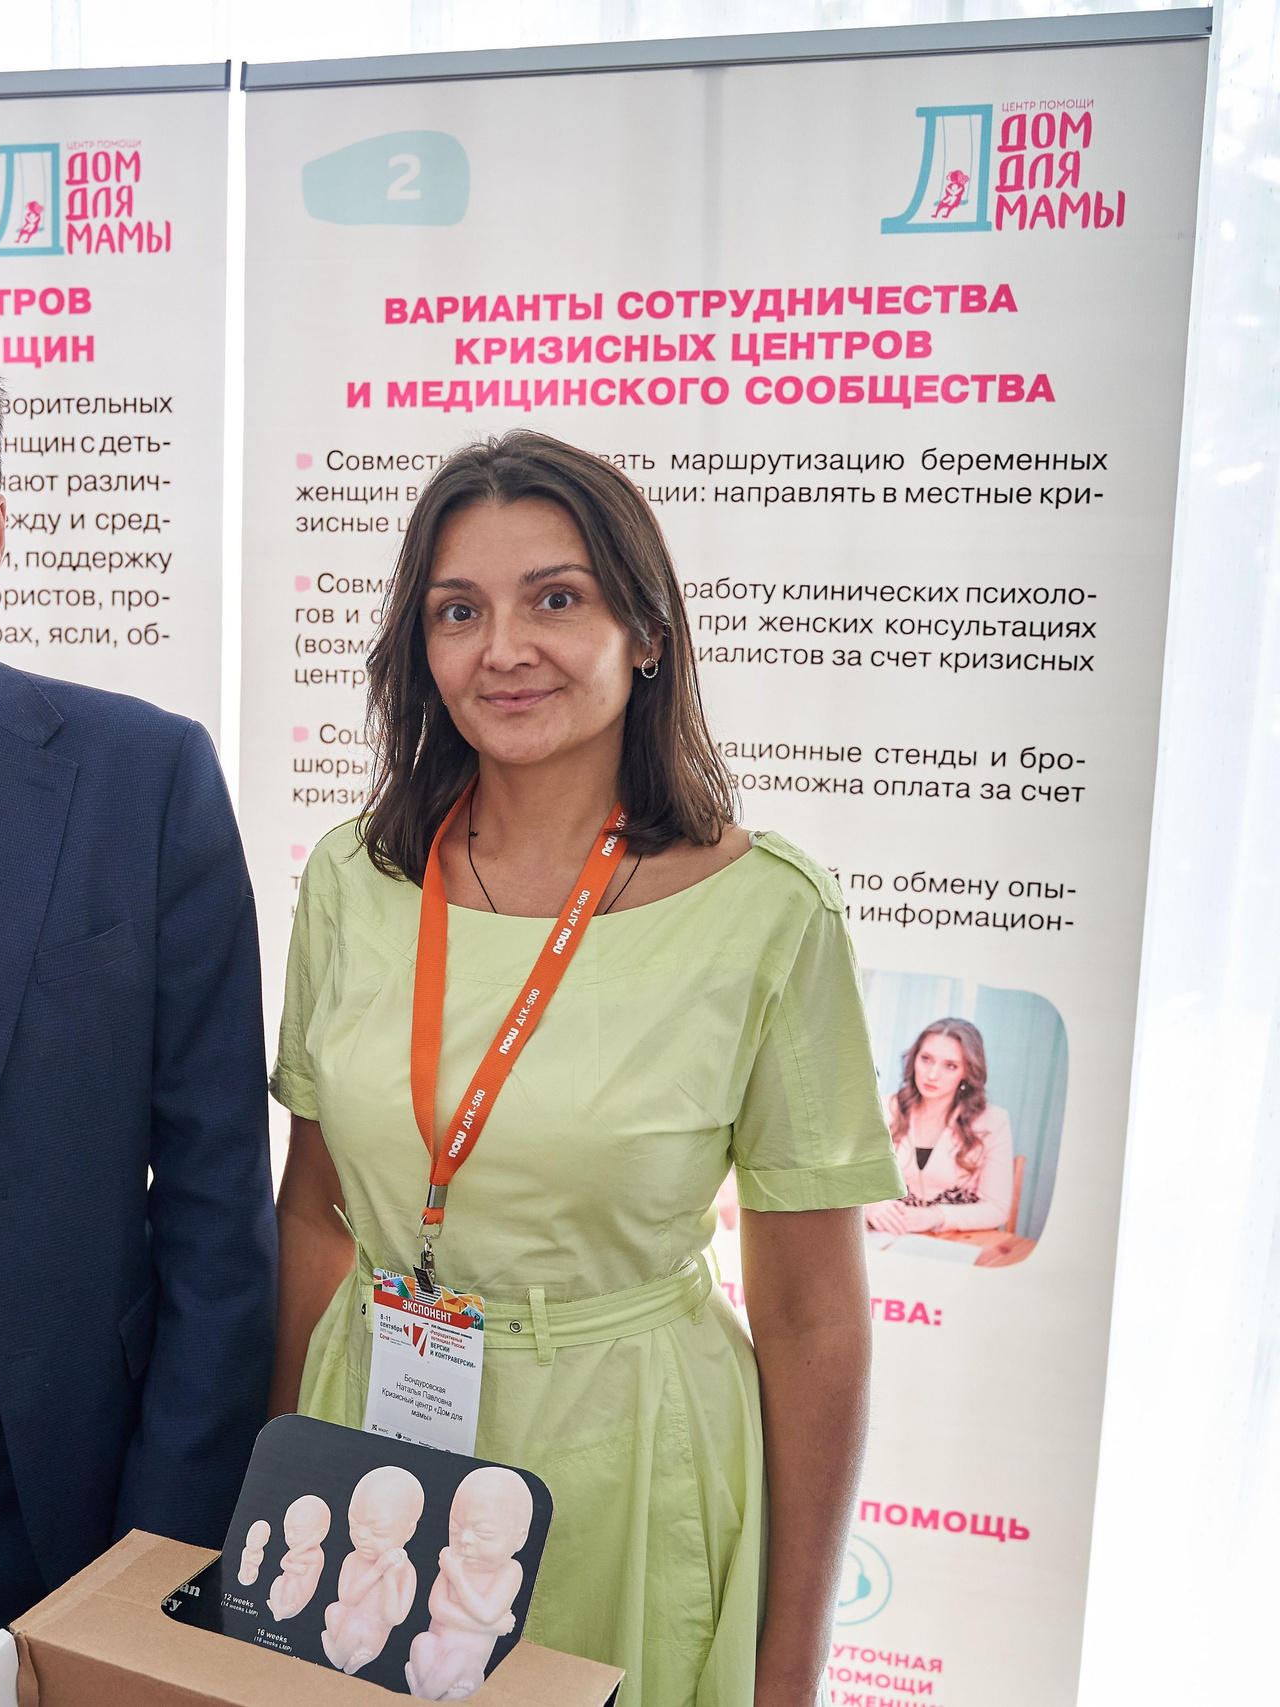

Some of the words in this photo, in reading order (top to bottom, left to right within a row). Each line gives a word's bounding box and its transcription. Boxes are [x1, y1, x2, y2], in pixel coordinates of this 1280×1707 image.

[1002, 101, 1036, 113] ЦЕНТР
[1040, 98, 1094, 111] ПОМОЩИ
[67, 140, 94, 150] ЦЕНТР
[97, 140, 142, 148] ПОМОЩИ
[999, 113, 1092, 152] ДОМ
[66, 151, 140, 185] ДОМ
[388, 156, 422, 200] 2
[999, 152, 1080, 193] ДЛЯ
[66, 185, 133, 220] ДЛЯ
[996, 192, 1126, 231] МАМЫ
[68, 221, 171, 254] МАМЫ
[385, 291, 603, 325] ВАРИАНТЫ
[617, 284, 1017, 322] СОТРУДНИЧЕСТВА
[455, 332, 716, 365] КРИЗИСНЫХ
[731, 329, 932, 366] ЦЕНТРОВ
[347, 381, 370, 407] И
[386, 375, 730, 413] МЕДИЦИНСКОГО
[746, 371, 1055, 409] СООБЩЕСТВА
[4, 397, 172, 419] ворительных
[4, 437, 74, 456] нщин
[82, 436, 94, 452] с
[99, 435, 170, 456] деть-
[326, 450, 447, 471] Совмест
[671, 453, 904, 475] маршрутизацию
[921, 448, 1108, 475] беременных
[68, 474, 170, 496] различ-
[296, 486, 398, 504] женщин
[407, 487, 418, 501] в
[715, 486, 875, 507] направлять
[883, 487, 897, 503] в
[906, 486, 1032, 503] местные
[1040, 487, 1104, 509] кри-
[72, 514, 84, 529] и
[96, 513, 170, 534] сред-
[296, 516, 389, 532] зисные
[27, 552, 172, 573] поддержку
[112, 590, 169, 611] про-
[684, 578, 776, 604] работу
[783, 584, 958, 603] клинических
[967, 587, 1097, 605] психоло-
[50, 628, 116, 646] ясли,
[128, 623, 169, 644] об-
[295, 609, 334, 624] гов
[346, 609, 359, 624] и
[699, 615, 746, 635] при
[758, 614, 873, 634] женских
[886, 619, 1096, 640] консультациях
[698, 646, 824, 666] иалистов
[832, 650, 861, 666] за
[871, 650, 931, 667] счет
[940, 651, 1094, 673] кризисных
[295, 668, 366, 688] центр
[723, 742, 862, 763] ационные
[875, 747, 977, 768] стенды
[991, 751, 1006, 767] и
[1021, 747, 1085, 774] бро-
[294, 758, 367, 778] шюры
[730, 774, 863, 795] возможна
[874, 779, 970, 798] оплата
[980, 782, 1010, 799] за
[1021, 784, 1085, 803] счет
[852, 874, 882, 891] по
[894, 872, 999, 900] обмену
[1008, 880, 1076, 899] опы-
[860, 903, 1074, 931] информацион-
[552, 928, 572, 955] now
[499, 1027, 519, 1055] now
[448, 1131, 467, 1158] now
[402, 1300, 451, 1323] ЭКСПОНЕНТ
[380, 1321, 402, 1333] сентября
[431, 1342, 449, 1353] ВЕРСИИ
[396, 1382, 421, 1396] Наталья
[423, 1389, 452, 1407] Павловна
[404, 1373, 445, 1394] Бондуровская
[382, 1388, 413, 1405] Кризисный
[415, 1398, 432, 1412] центр
[434, 1406, 450, 1417] «Дом
[451, 1412, 463, 1421] для
[412, 1410, 432, 1421] мамы»
[860, 1500, 1030, 1542] ПОМОЩЬ
[233, 1597, 254, 1608] weeks
[257, 1628, 265, 1636] 16
[266, 1632, 287, 1643] weeks
[833, 1644, 943, 1673] УТОЧНАЯ
